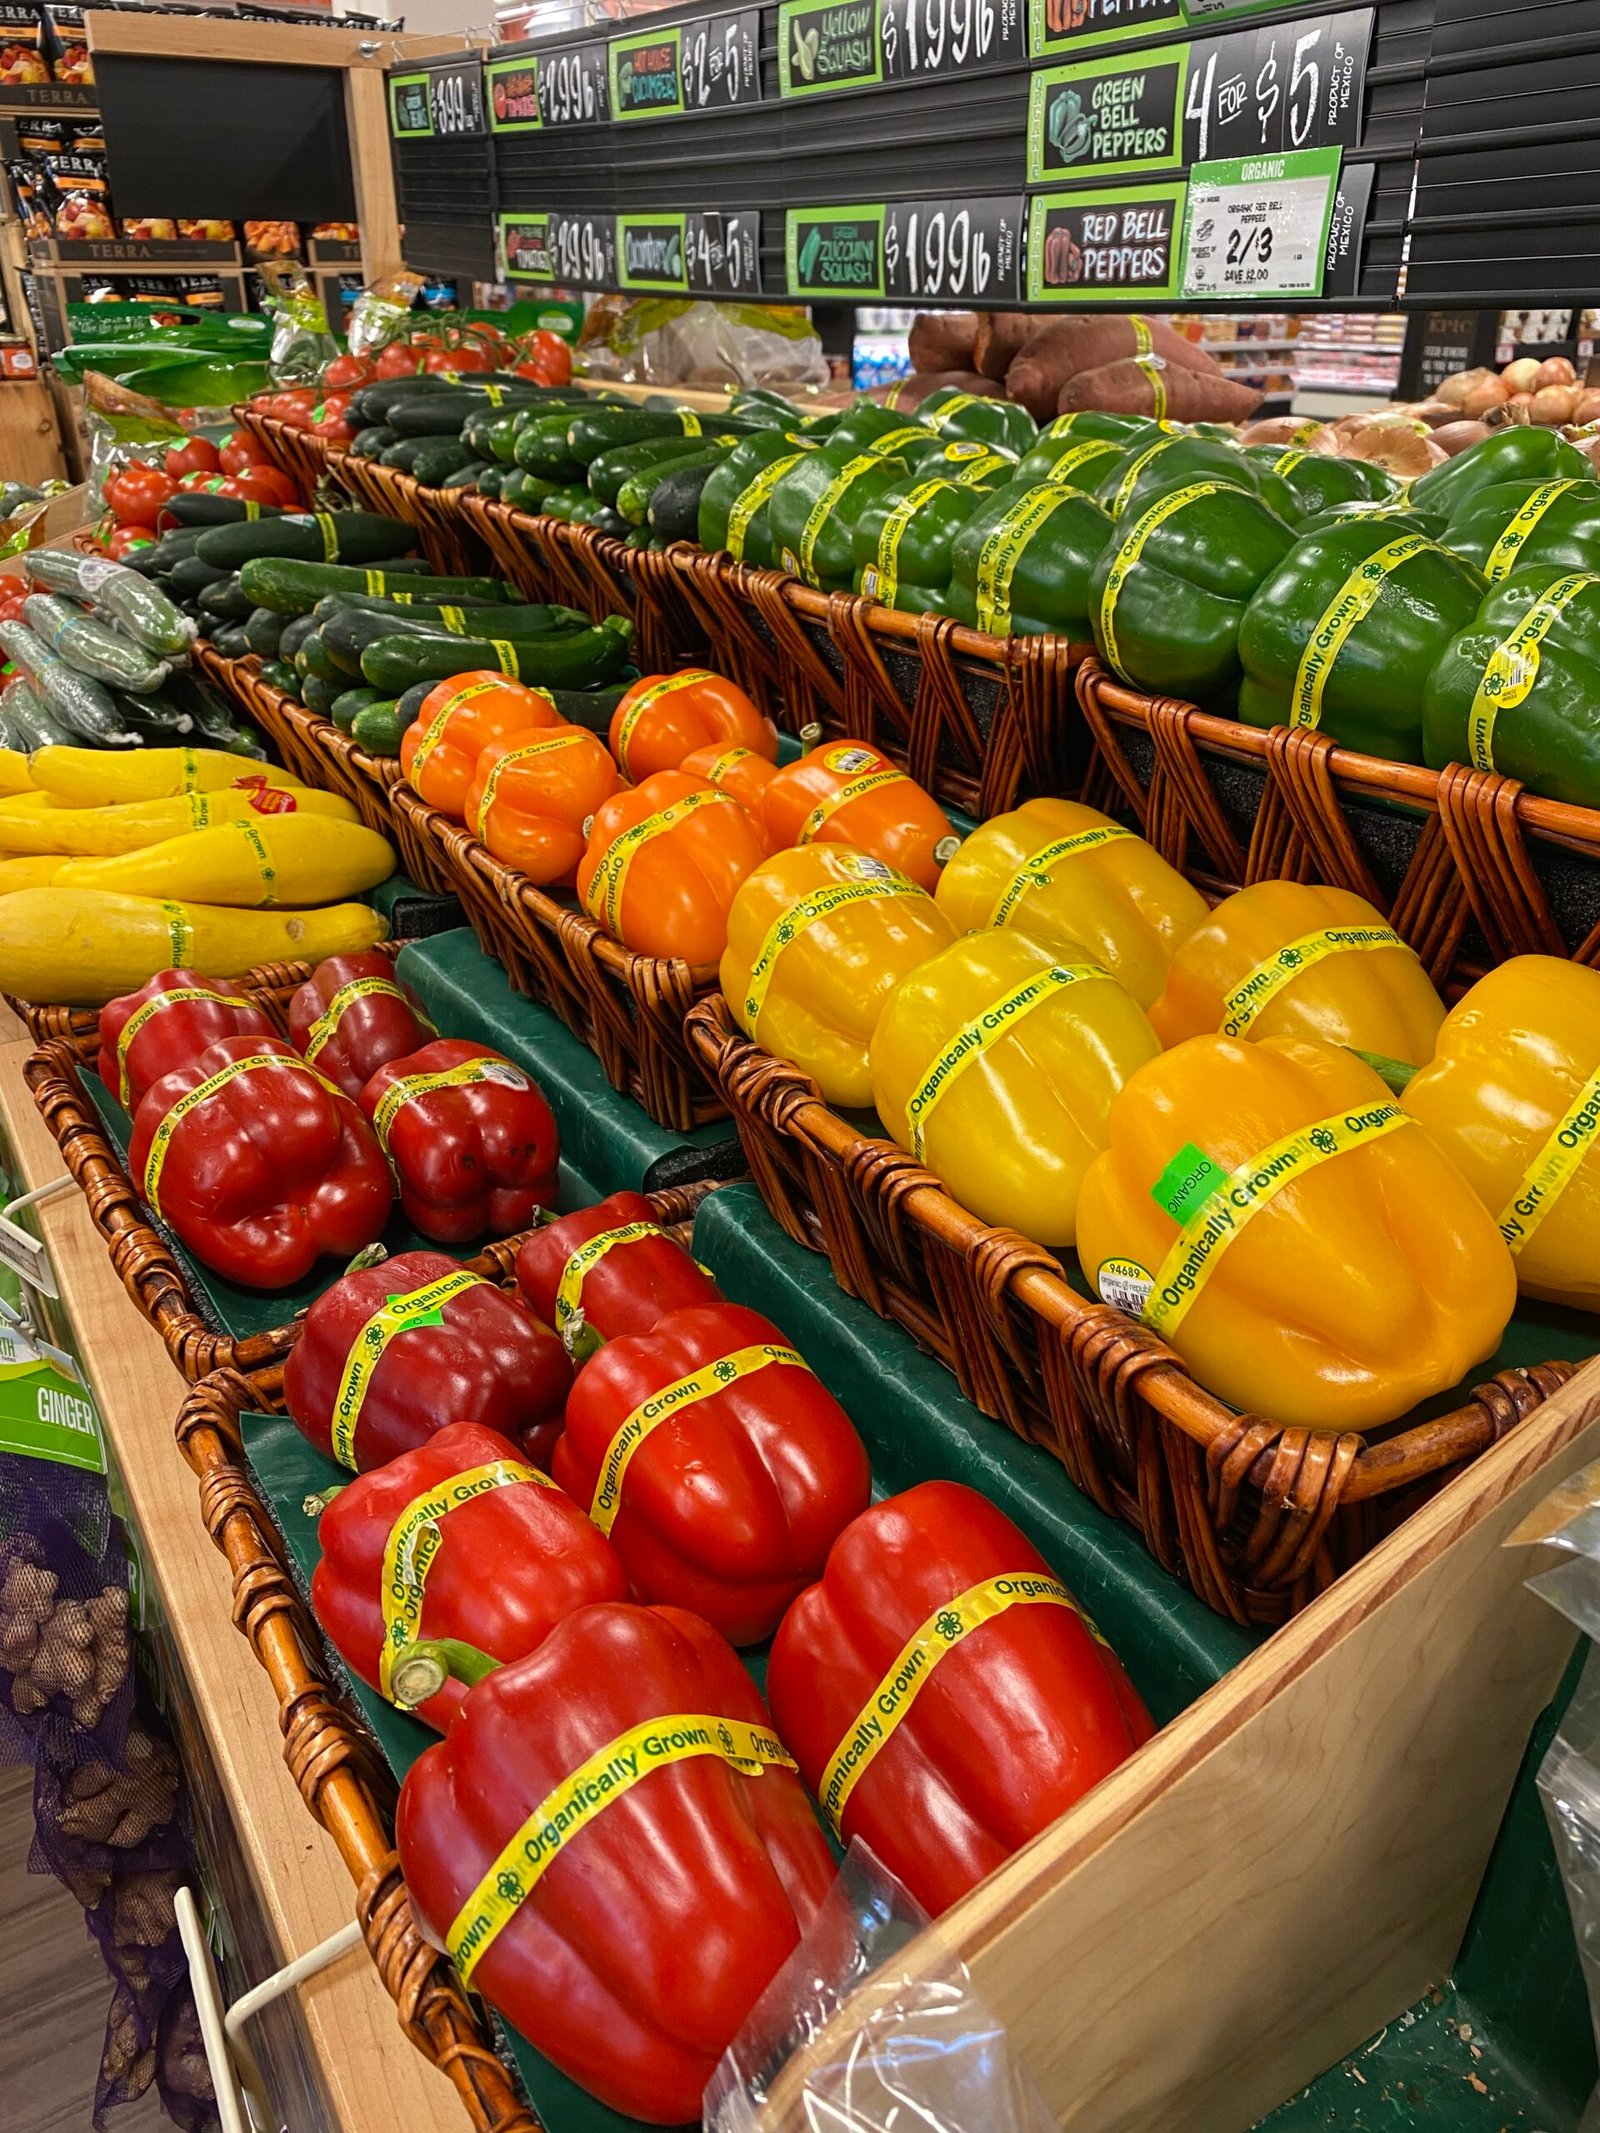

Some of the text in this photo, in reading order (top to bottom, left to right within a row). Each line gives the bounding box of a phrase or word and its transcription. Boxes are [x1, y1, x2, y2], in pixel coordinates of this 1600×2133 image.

[818, 37, 872, 75] SQUASH
[27, 89, 88, 104] TERRA
[1091, 74, 1147, 110] GREEN
[1327, 42, 1345, 126] PRODUCT OF
[1340, 55, 1354, 109] MEXICO
[1100, 103, 1140, 130] BELL
[1185, 51, 1218, 161] 4
[1218, 80, 1248, 119] FOR
[1092, 126, 1169, 160] PEPPERS
[1241, 159, 1286, 181] ORGANIC
[833, 226, 859, 239] GREEN
[1081, 209, 1169, 244] RED BELL
[1327, 190, 1346, 271] PRODUCT OF
[1340, 205, 1354, 256] MEXICO
[89, 243, 151, 258] TERRA
[819, 239, 875, 262] ZUCCHINI
[1082, 246, 1166, 281] PEPPERS
[820, 261, 874, 283] SQUASH
[1224, 268, 1269, 282] SAVE $2.00
[1428, 317, 1474, 335] EPIC
[764, 456, 798, 478] Grown
[808, 491, 835, 528] Grown
[1011, 502, 1047, 541] Grown
[1123, 489, 1190, 557] Organically
[1104, 609, 1118, 658] Grown
[1316, 593, 1358, 649] Grown
[625, 694, 651, 728] Grown
[526, 739, 567, 755] Grown
[1476, 717, 1488, 773] Grown
[249, 829, 268, 860] Grown
[1029, 830, 1108, 868] Organically
[588, 858, 610, 900] Grown
[804, 882, 890, 918] Organically
[1324, 930, 1400, 945] Organically
[127, 988, 191, 1037] Organally
[910, 984, 1041, 1115] Organically Grown
[175, 1061, 248, 1115] Organically
[400, 1080, 449, 1102] Grown
[145, 1152, 159, 1196] Grown
[1167, 1160, 1212, 1215] ORGANIC
[569, 1223, 643, 1272] Organically
[1161, 1151, 1299, 1308] Organically Grown
[1100, 1276, 1123, 1290] organic
[1108, 1263, 1141, 1279] 94689
[391, 1272, 477, 1315] Organically
[339, 1361, 364, 1418] Grown
[37, 1386, 96, 1437] GINGER
[597, 1380, 702, 1511] Organically Grown
[391, 1471, 521, 1601] Organically Grown
[822, 1647, 928, 1824] Organically Grown
[523, 1725, 711, 1865] Organically Grown
